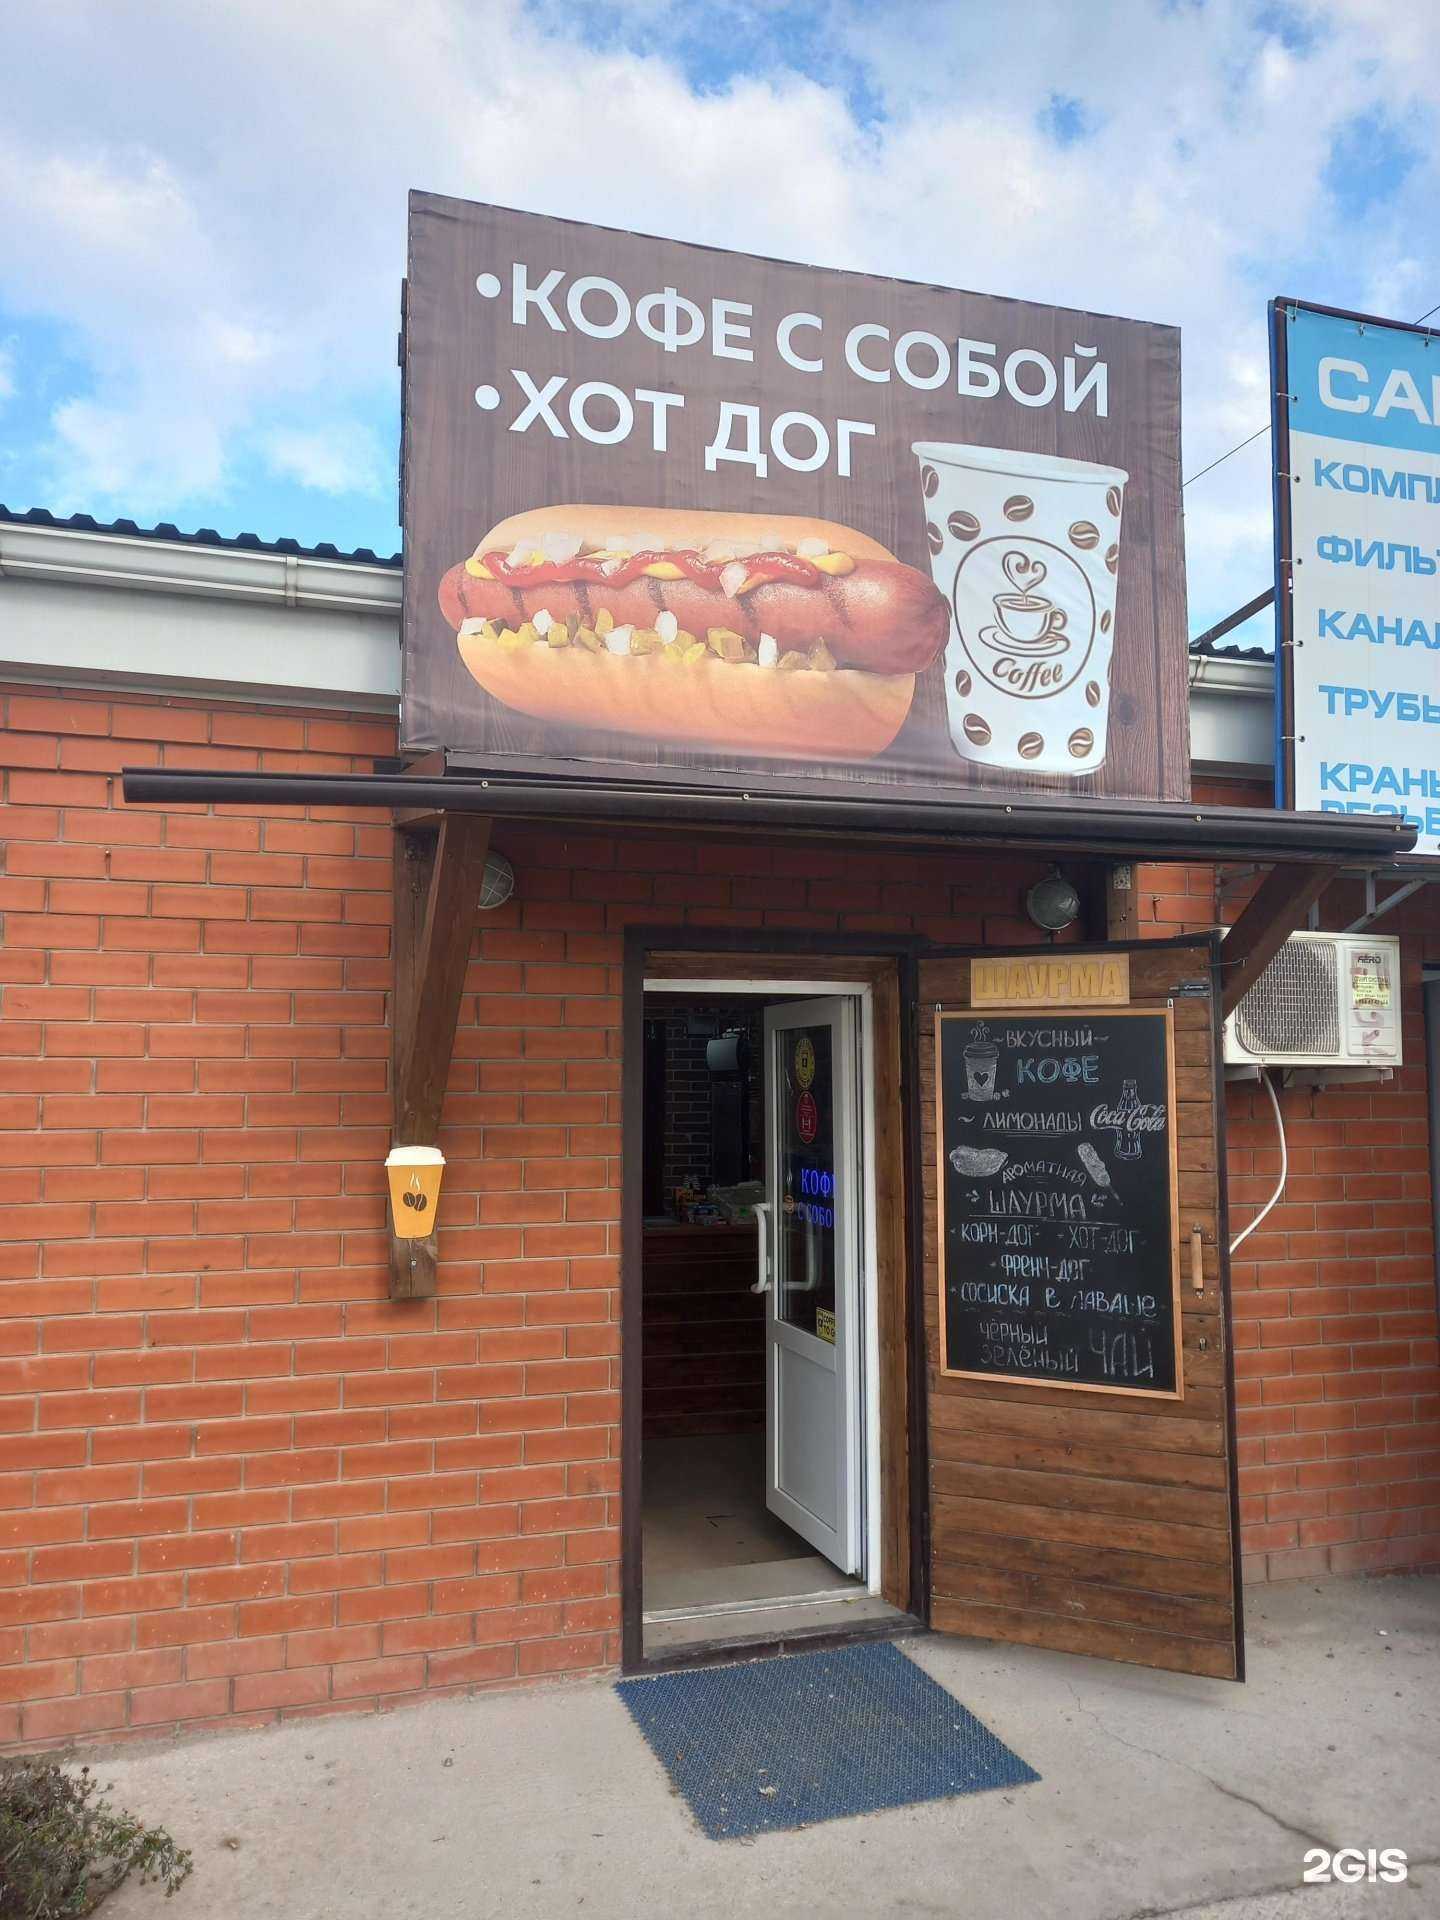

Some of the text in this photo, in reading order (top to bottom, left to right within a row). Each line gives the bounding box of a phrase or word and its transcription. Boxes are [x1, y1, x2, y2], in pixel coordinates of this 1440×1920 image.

[511, 263, 1110, 418] КОФЕ С СОБОЙ
[1318, 356, 1440, 426] СА
[508, 370, 876, 478] ХОТ ДОГ
[1314, 458, 1440, 504] КОМП
[1317, 535, 1440, 576] ФИЛЬ
[1318, 608, 1440, 650] КАНА
[992, 657, 1063, 692] Coffee
[974, 961, 1123, 1000] ШАУРМА
[1006, 1025, 1094, 1048] ВКУСНЫЙ
[1016, 1055, 1100, 1084] КОФЕ
[982, 1111, 1082, 1132] ЛИМОНАДЫ
[801, 1168, 837, 1198] КОФ
[1002, 1160, 1087, 1186] АРОМАТНАЯ
[806, 1203, 834, 1229] СОБО
[988, 1190, 1087, 1220] ШАУРМА
[961, 1282, 1030, 1306] СОСИСКА
[1089, 1327, 1154, 1379] ЧАЙ
